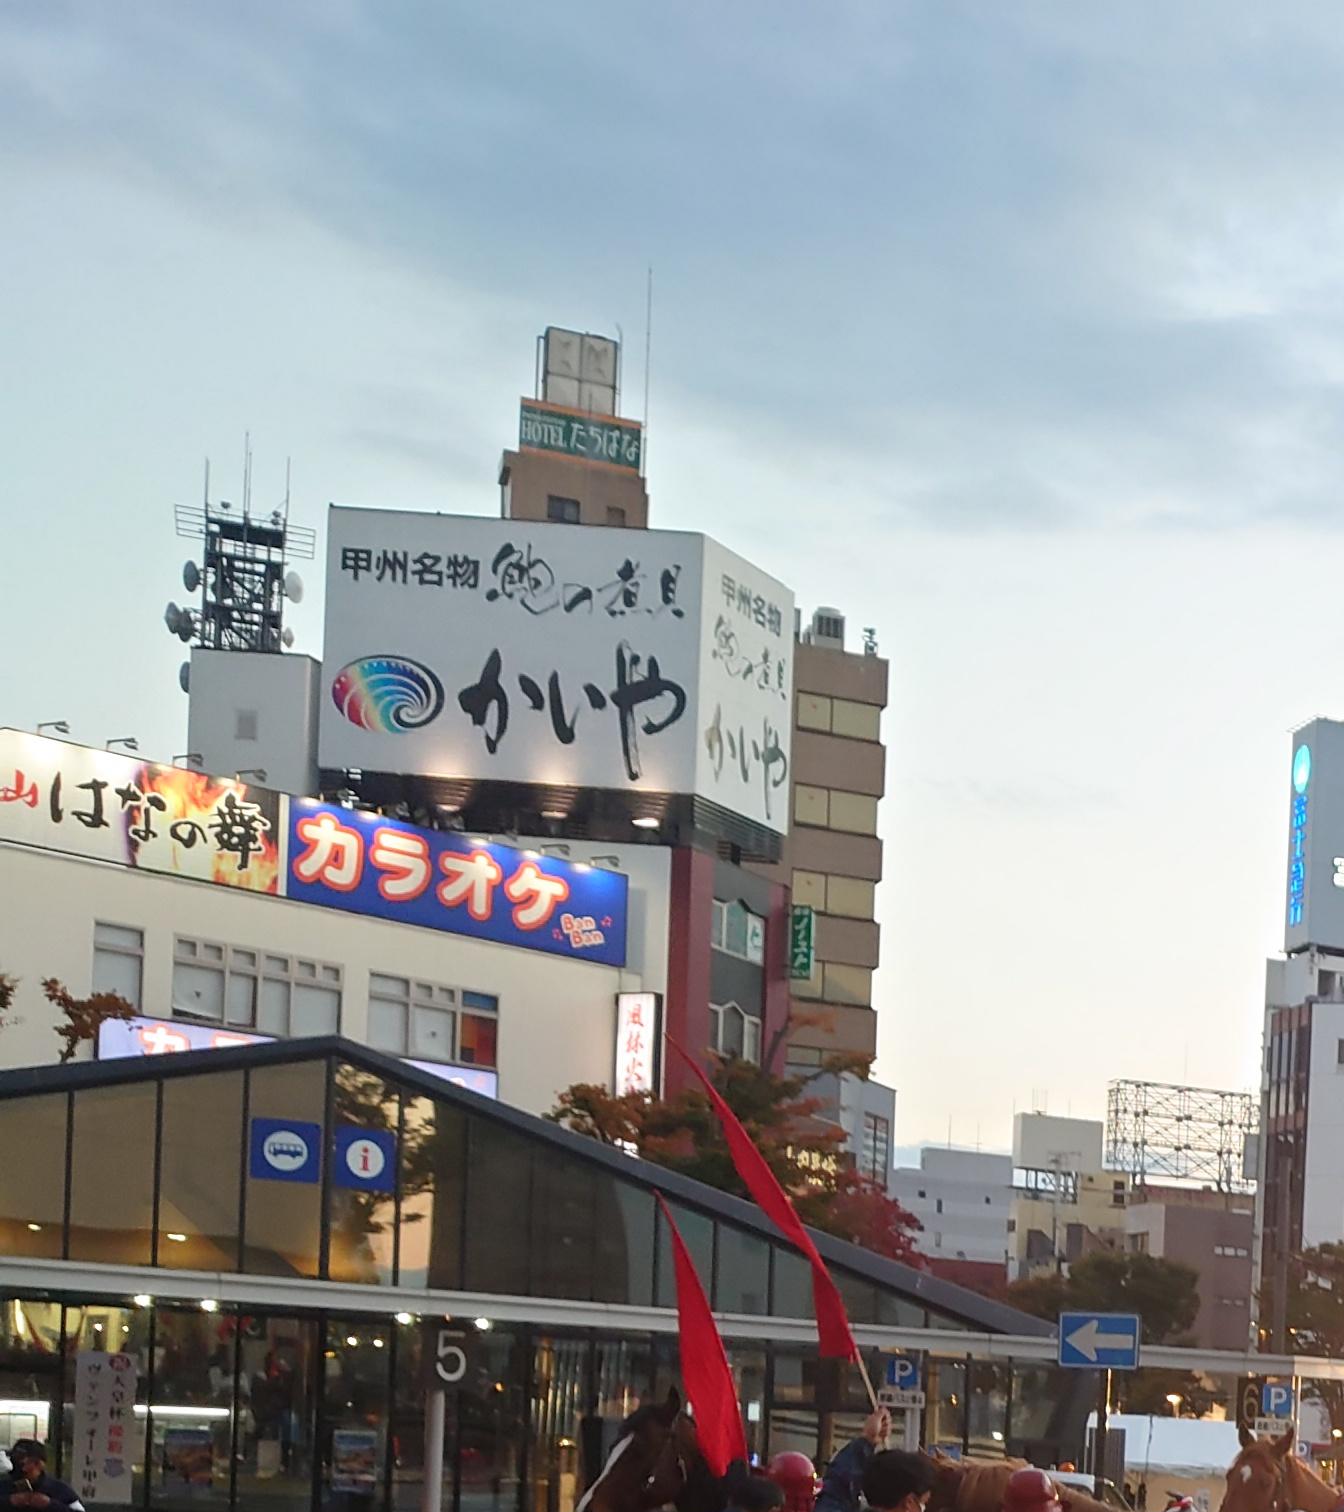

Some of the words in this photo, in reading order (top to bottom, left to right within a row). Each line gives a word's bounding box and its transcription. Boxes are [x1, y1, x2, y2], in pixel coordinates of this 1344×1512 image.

[522, 419, 568, 448] HOTEL
[570, 422, 640, 461] たちばな
[341, 547, 481, 589] 甲州名物
[721, 574, 782, 638] 甲州名物
[458, 639, 686, 781] かいや
[705, 702, 788, 820] かいや
[51, 771, 272, 871] はなの舞
[294, 812, 571, 931] カラオケ
[560, 913, 595, 934] Ban
[569, 929, 606, 949] Ban
[435, 1331, 468, 1382] 5
[894, 1359, 913, 1384] P
[1270, 1386, 1287, 1412] P
